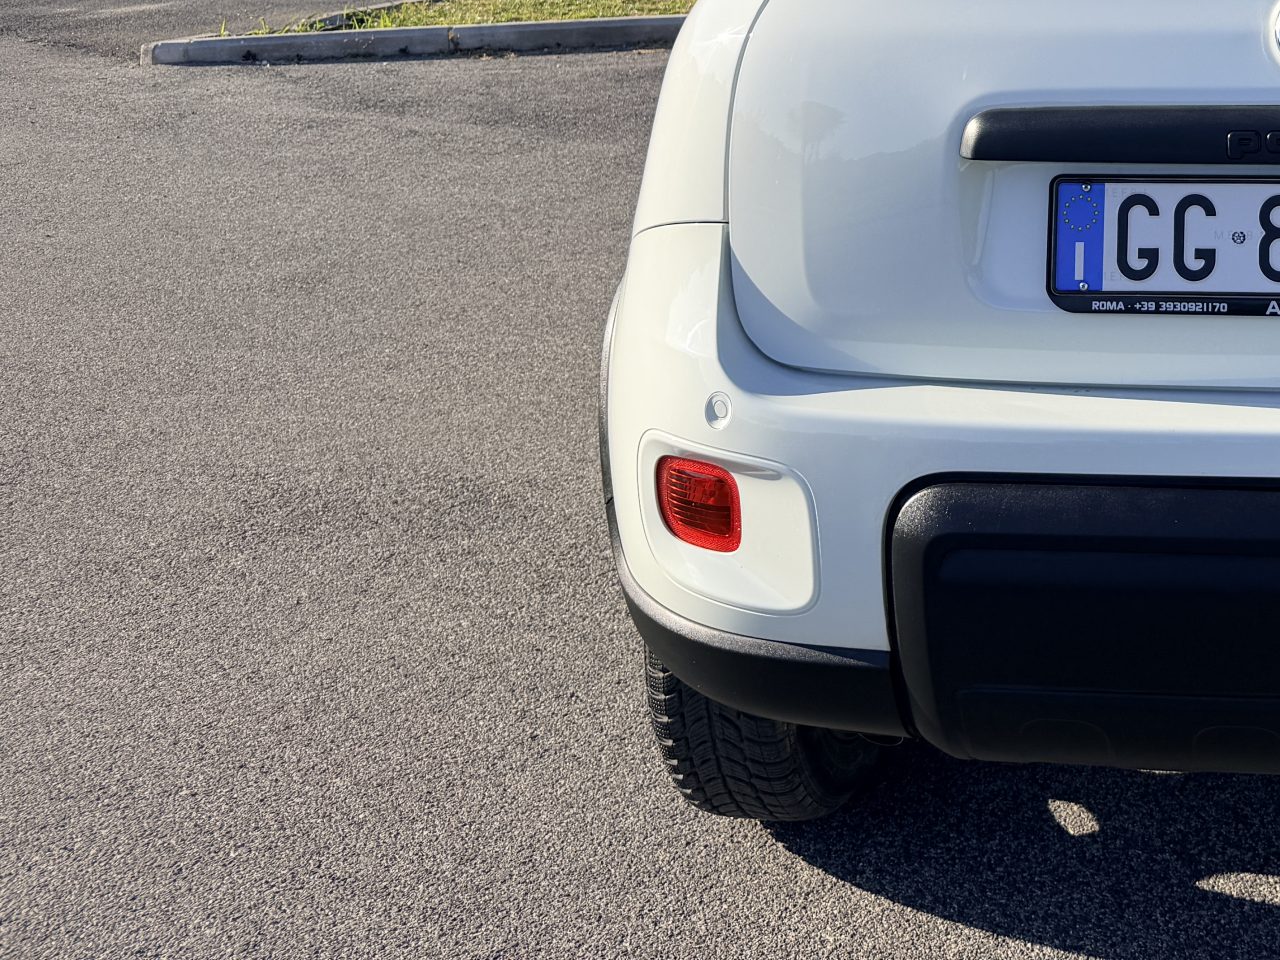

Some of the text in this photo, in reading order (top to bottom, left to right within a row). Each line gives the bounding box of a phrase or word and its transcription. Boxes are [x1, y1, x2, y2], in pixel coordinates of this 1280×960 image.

[1116, 193, 1217, 282] GG
[1091, 300, 1125, 311] ROMA
[1133, 301, 1156, 311] +39
[1158, 301, 1228, 313] 3930921170
